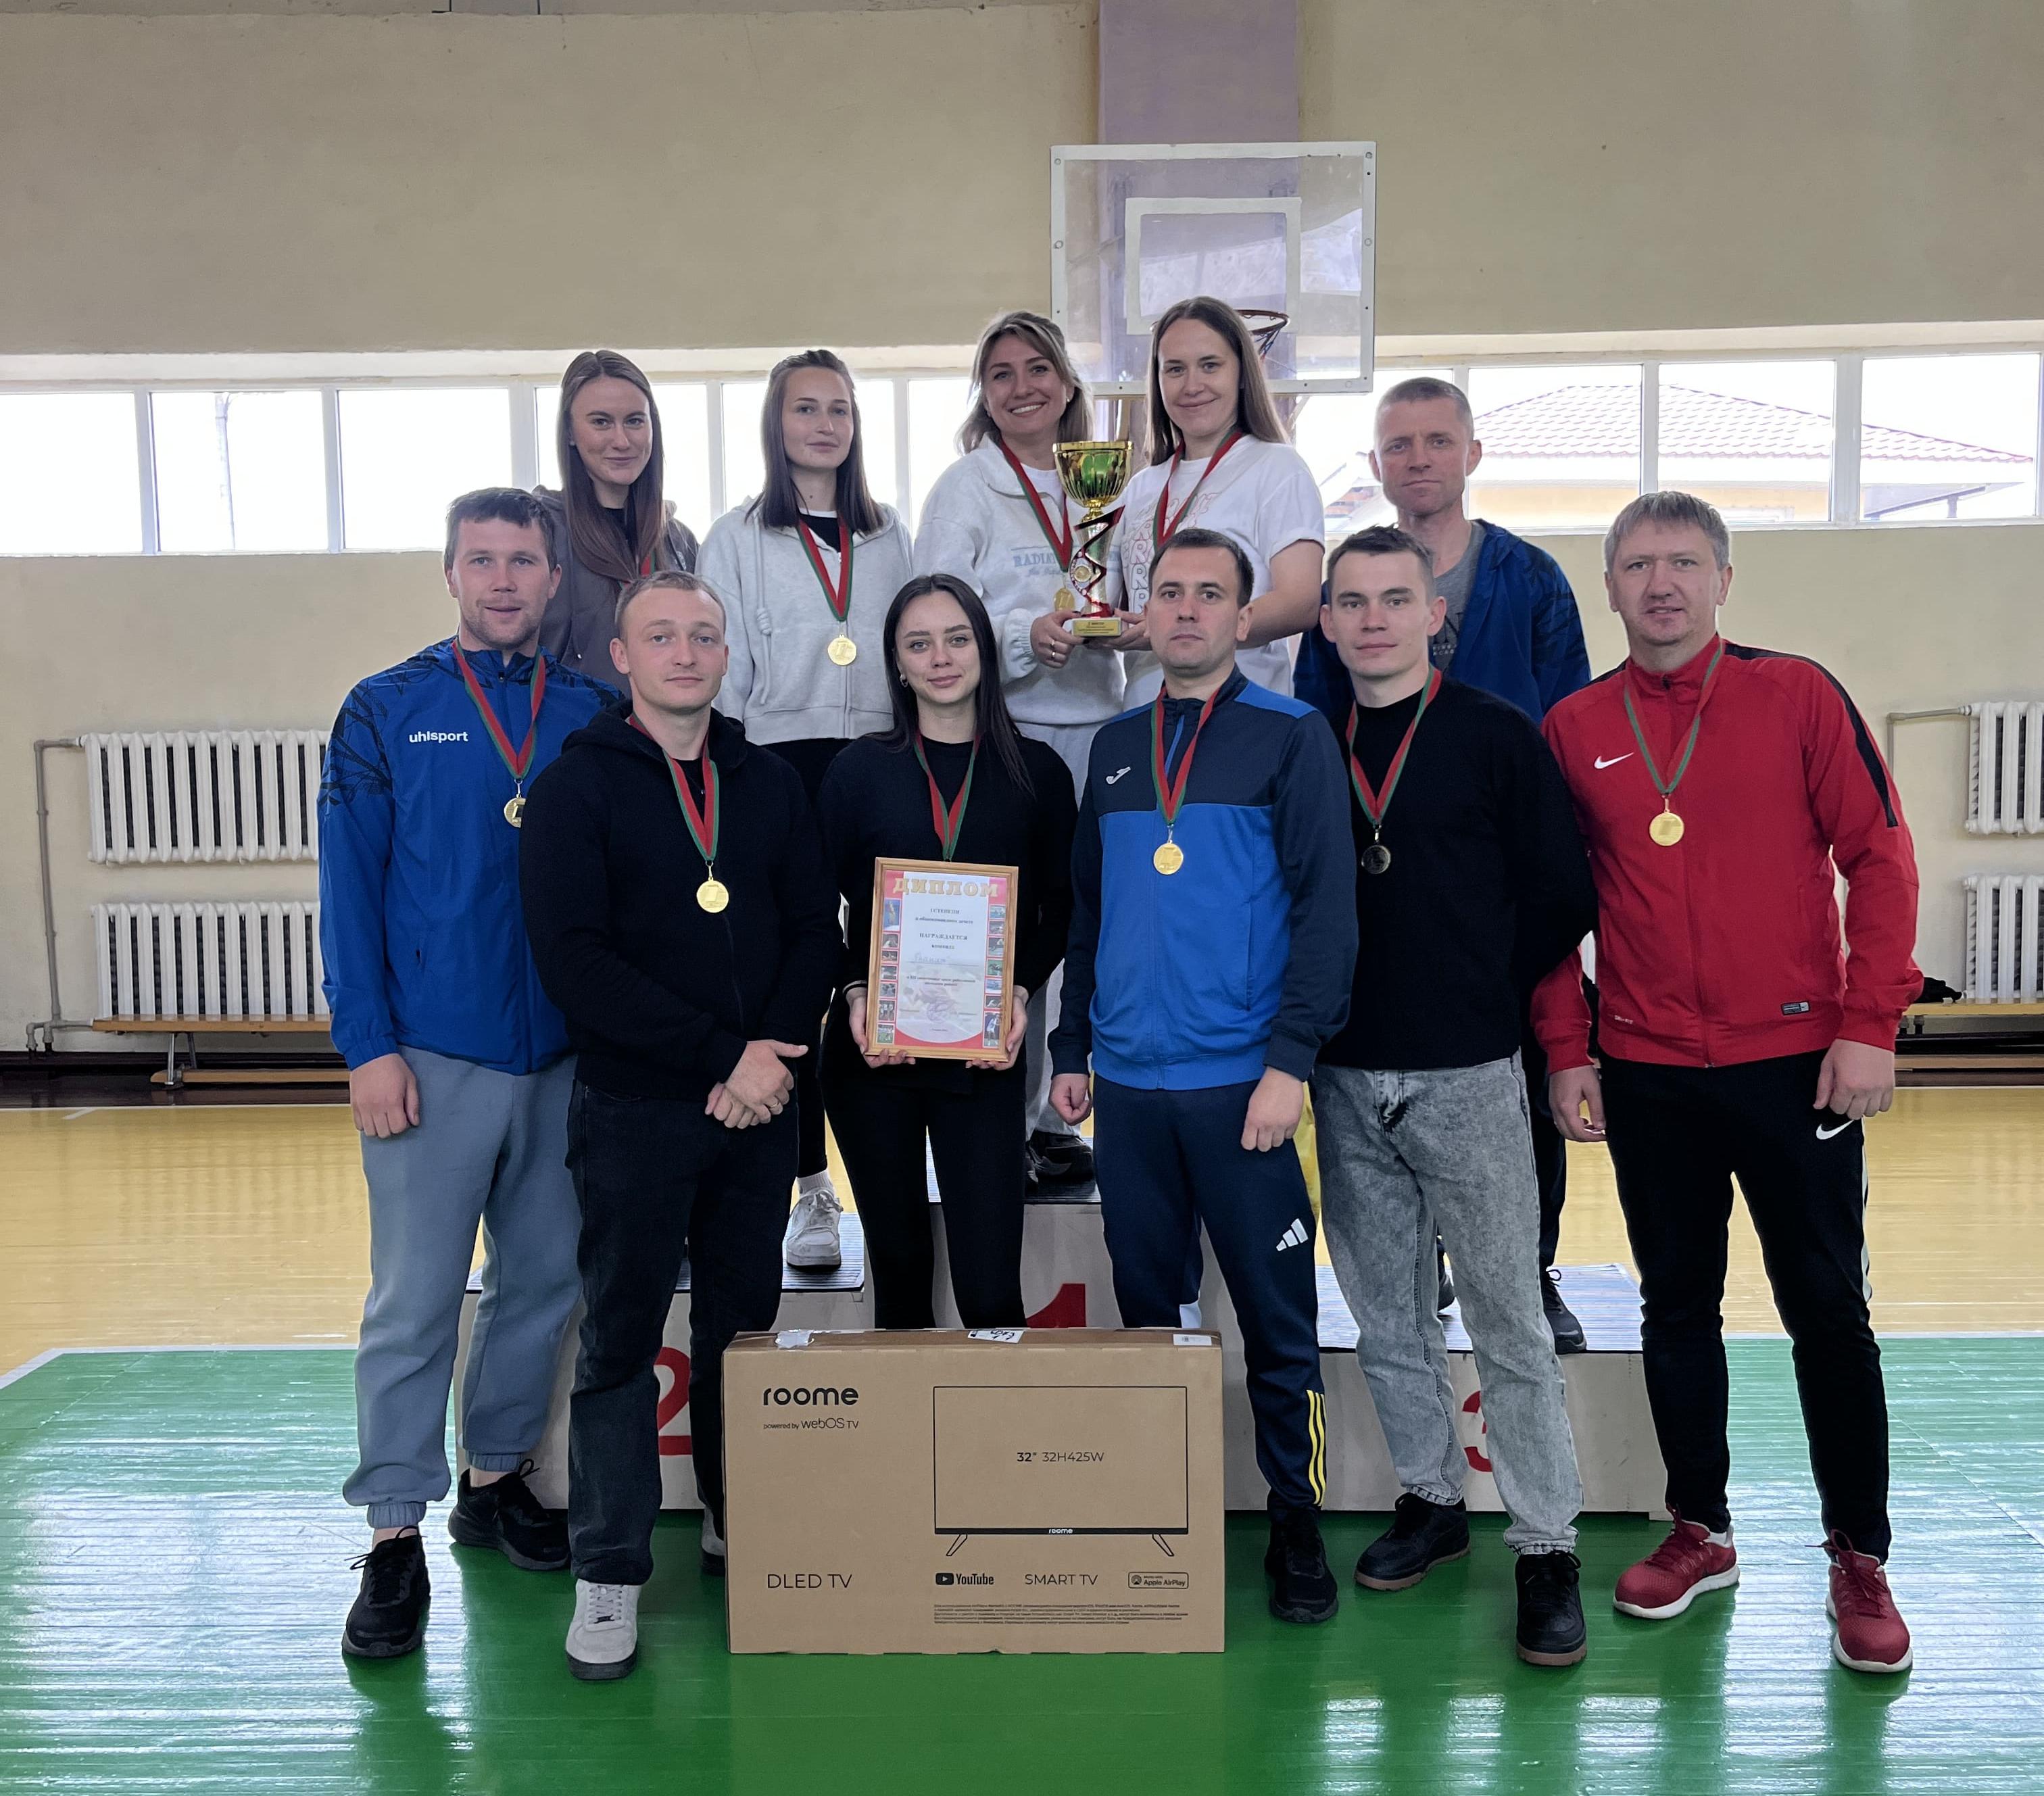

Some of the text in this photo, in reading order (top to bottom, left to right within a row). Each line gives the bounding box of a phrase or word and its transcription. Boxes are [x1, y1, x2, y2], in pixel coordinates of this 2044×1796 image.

[408, 731, 468, 743] uhlsport
[893, 877, 998, 898] ДИПЛОМ
[763, 1388, 859, 1406] roome
[801, 1417, 844, 1429] webOS
[847, 1420, 859, 1429] TV
[1042, 1452, 1104, 1462] 32H425W
[767, 1574, 852, 1588] DLED TV
[956, 1573, 994, 1586] YouTube
[1025, 1574, 1098, 1585] SMART TV
[1163, 1579, 1186, 1587] AirPlay
